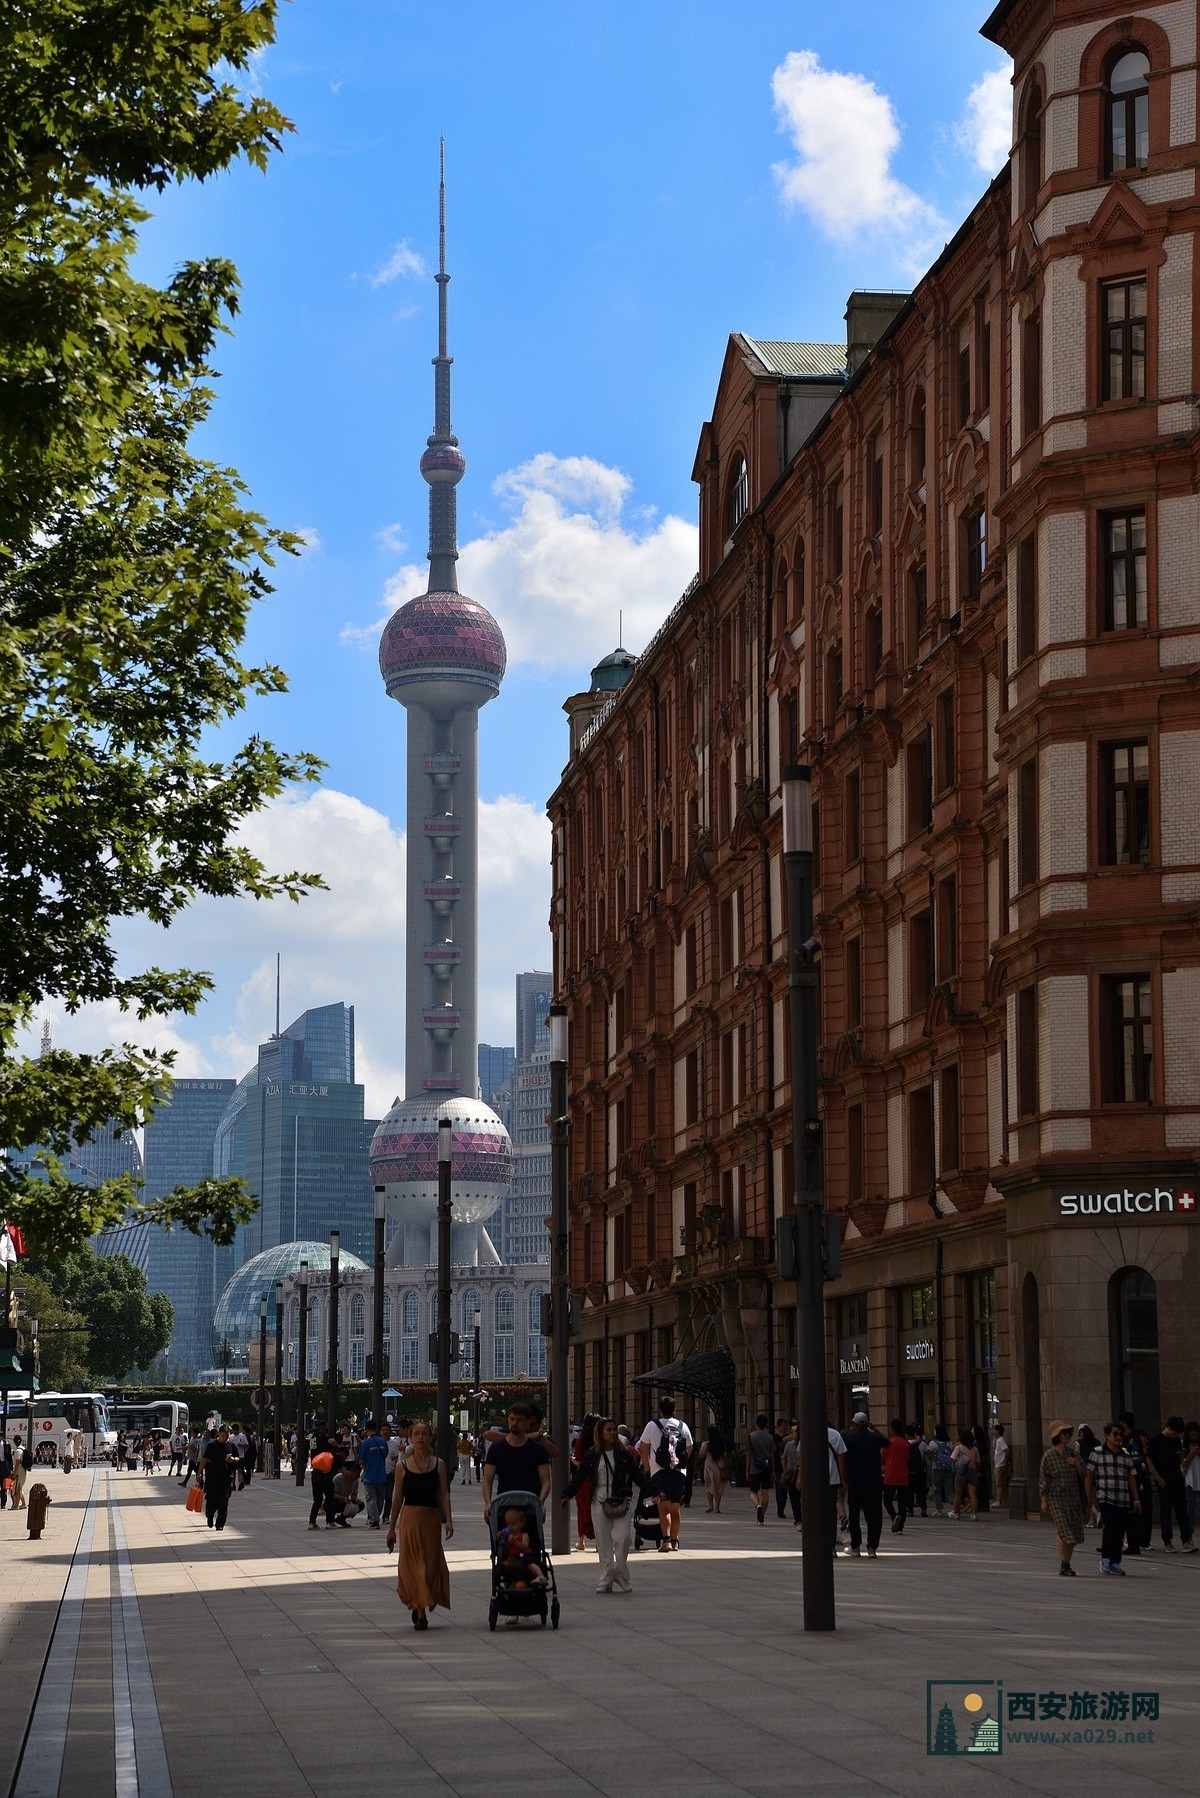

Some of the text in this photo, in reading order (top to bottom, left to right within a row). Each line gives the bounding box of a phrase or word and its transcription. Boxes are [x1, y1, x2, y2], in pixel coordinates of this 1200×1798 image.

[265, 1084, 280, 1097] AZIA
[289, 1084, 329, 1097] 汇亚大厦
[1060, 1188, 1174, 1215] swatch
[906, 1339, 930, 1360] swatch
